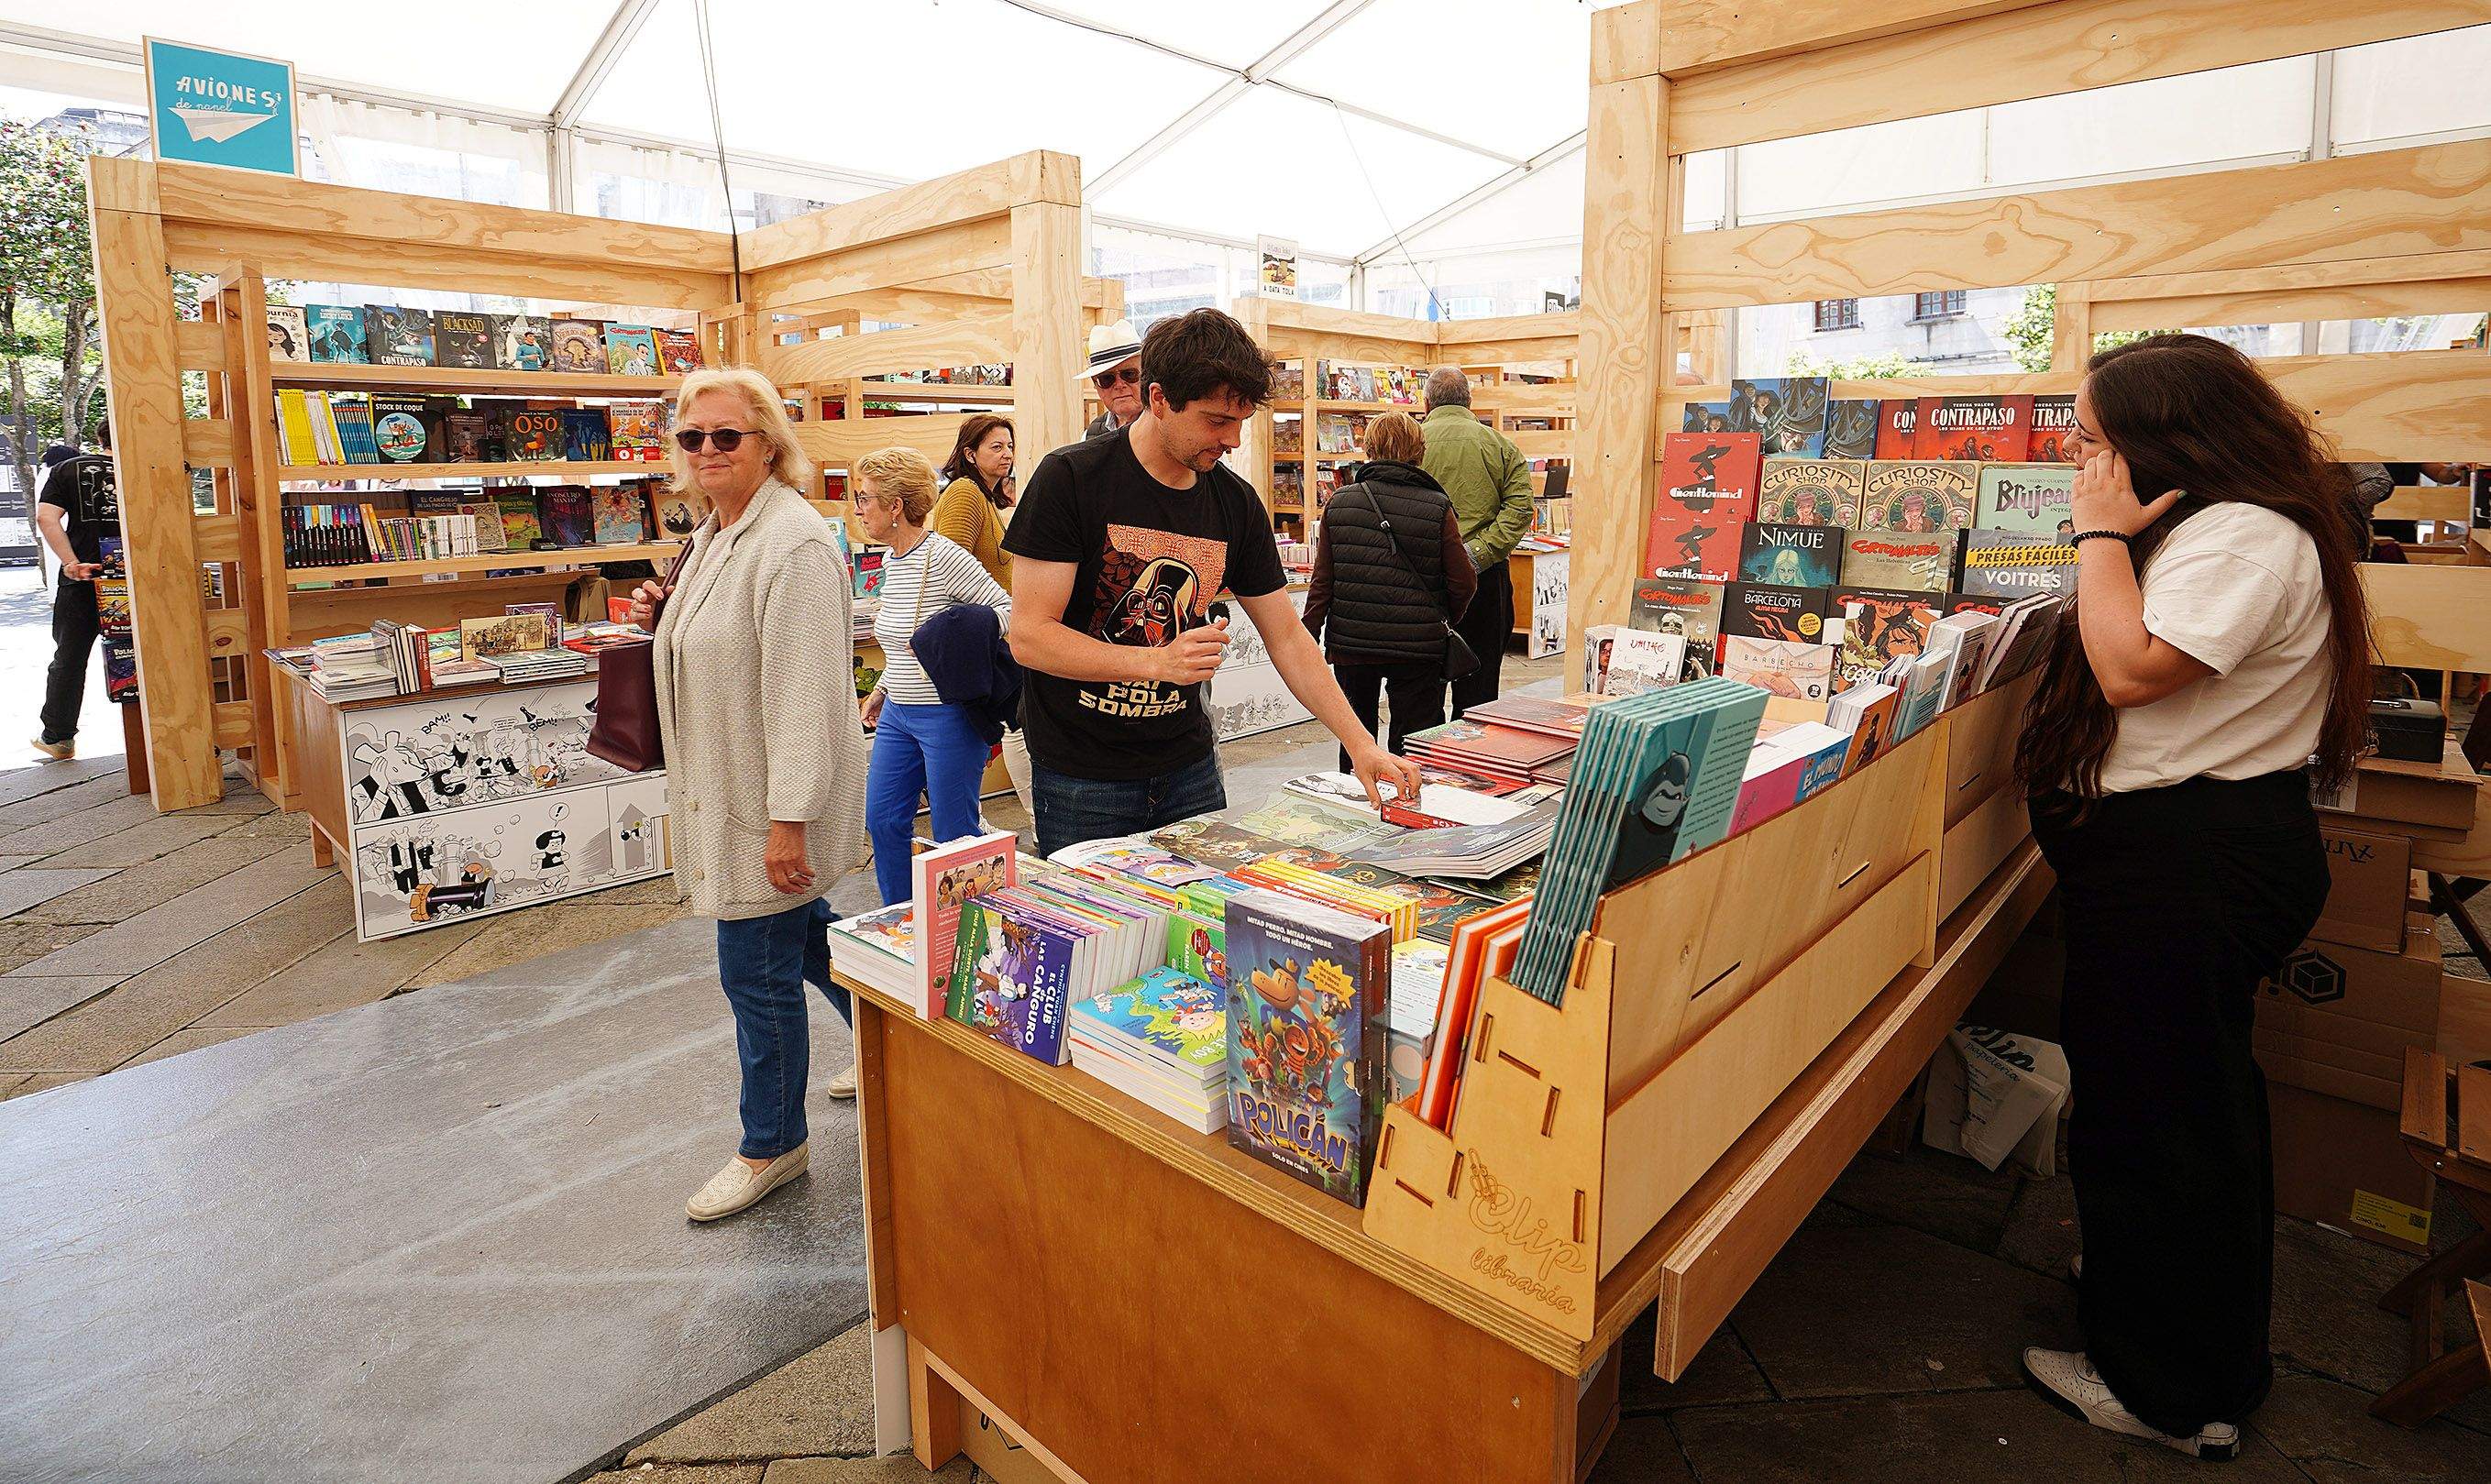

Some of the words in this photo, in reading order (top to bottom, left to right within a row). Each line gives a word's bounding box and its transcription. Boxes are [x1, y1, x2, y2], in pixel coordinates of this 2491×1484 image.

[176, 76, 276, 108] AVIONES
[176, 97, 192, 108] de
[443, 317, 485, 333] BLACKSAD
[381, 356, 427, 367] CONTRAPASO
[515, 415, 557, 434] OSO
[1930, 407, 2015, 426] CONTRAPASO
[1763, 465, 1860, 490] CURIOSITY
[1796, 476, 1827, 485] SHOP
[1868, 466, 1973, 493] CURIOSITY
[1903, 478, 1937, 488] SHOP
[1669, 487, 1743, 500] Gentlemind
[1758, 526, 1824, 549] NIMUE
[1976, 552, 2023, 563] PRESAS
[1655, 567, 1729, 582] Gentlemind
[1744, 593, 1802, 609] BARCELONA
[1630, 639, 1667, 654] UMIKO
[1744, 654, 1814, 669] BARBECHO
[1078, 688, 1187, 718] SOMBRA
[1108, 683, 1180, 705] POLA
[421, 713, 451, 735] BAM!!
[528, 717, 558, 732] BEM!!
[1247, 916, 1265, 928] MITAD
[1265, 921, 1286, 935] PERRO,
[1286, 929, 1306, 940] MITAD
[1305, 935, 1334, 950] HOMBRE.
[1265, 929, 1284, 942] TODO
[1284, 935, 1293, 945] UN
[1292, 937, 1314, 951] HÉROE.
[1038, 940, 1046, 962] LAS
[1048, 972, 1056, 984] EL
[1057, 963, 1065, 995] CYNTHIA
[1025, 963, 1045, 1045] CANGURO
[1040, 989, 1045, 1003] de
[1042, 984, 1056, 1025] CLUB
[1239, 1092, 1349, 1172] POLICÁN
[1272, 1151, 1286, 1163] SOLO
[1285, 1159, 1294, 1167] EN
[1294, 1161, 1309, 1174] CINES
[1469, 1184, 1587, 1281] Clip
